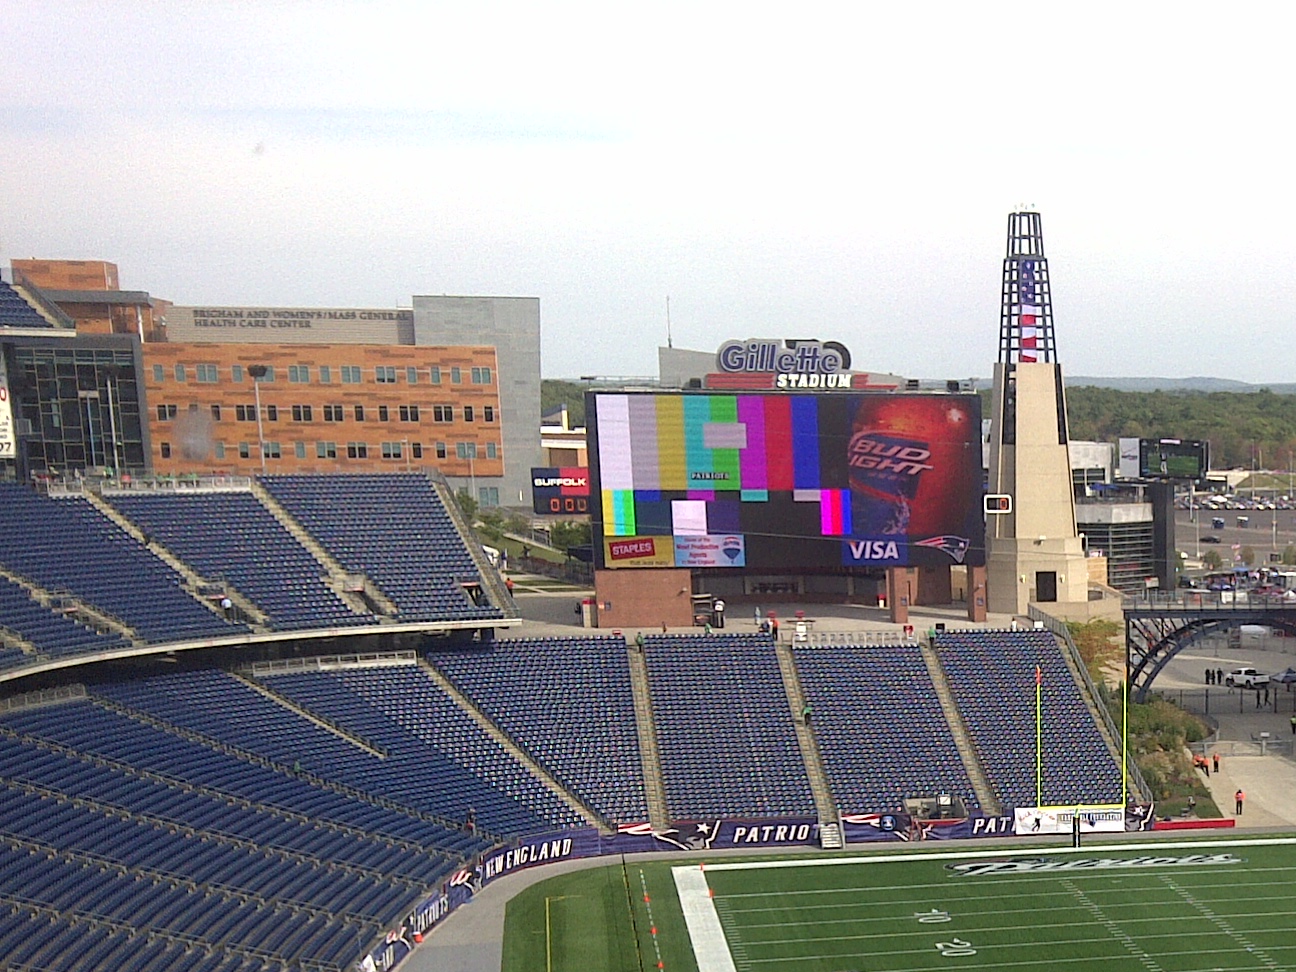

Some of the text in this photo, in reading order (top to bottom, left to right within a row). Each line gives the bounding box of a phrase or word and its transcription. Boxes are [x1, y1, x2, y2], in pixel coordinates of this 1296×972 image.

[194, 319, 312, 328] HEALTH CARE CENTER
[247, 310, 270, 319] AND
[359, 312, 410, 321] GENERAL
[720, 342, 840, 373] Gillette
[776, 373, 852, 388] STADIUM
[853, 439, 931, 461] BUD
[850, 454, 934, 475] IGHT
[534, 478, 587, 487] SUFFOLK
[612, 541, 653, 556] STAPLES
[848, 540, 899, 559] VISA
[485, 838, 573, 880] NEW ENGLAND
